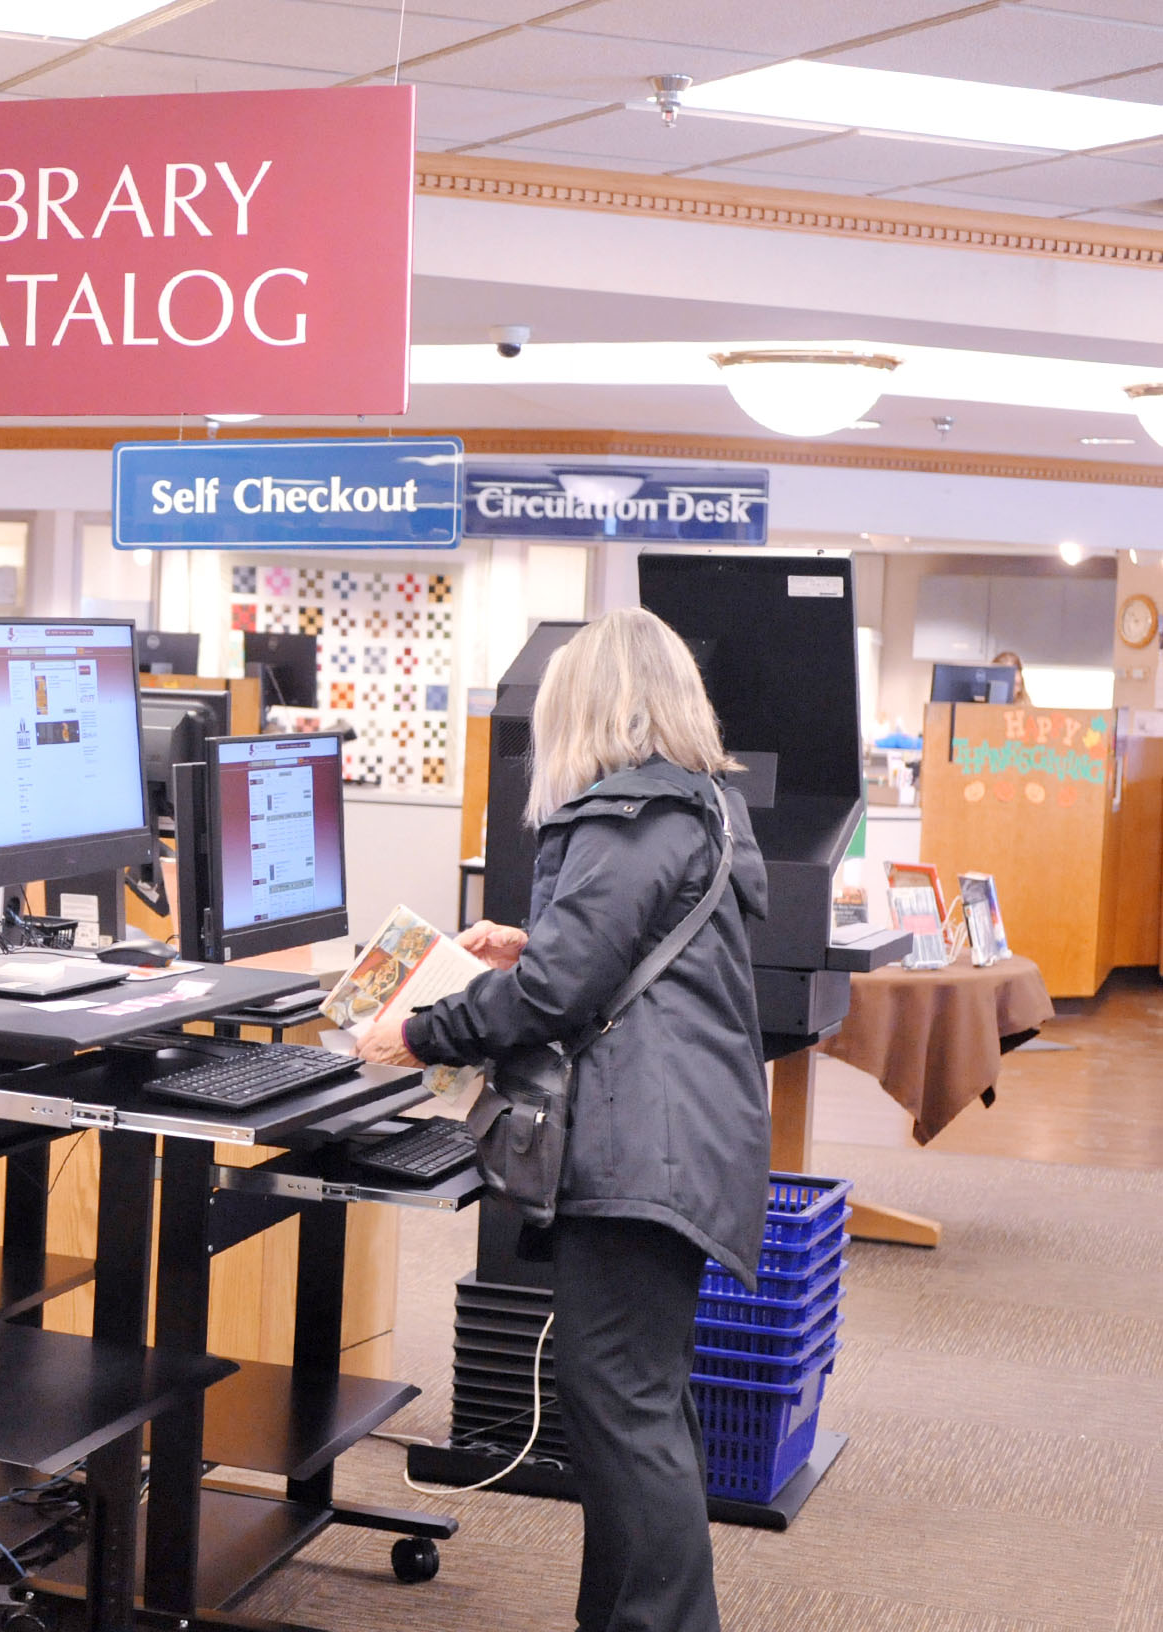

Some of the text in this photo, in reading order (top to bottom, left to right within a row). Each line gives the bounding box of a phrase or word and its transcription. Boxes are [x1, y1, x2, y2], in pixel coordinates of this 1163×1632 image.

[151, 476, 418, 515] Self Checkout
[475, 487, 751, 523] Circulation Desk
[1003, 709, 1081, 747] HAPPY
